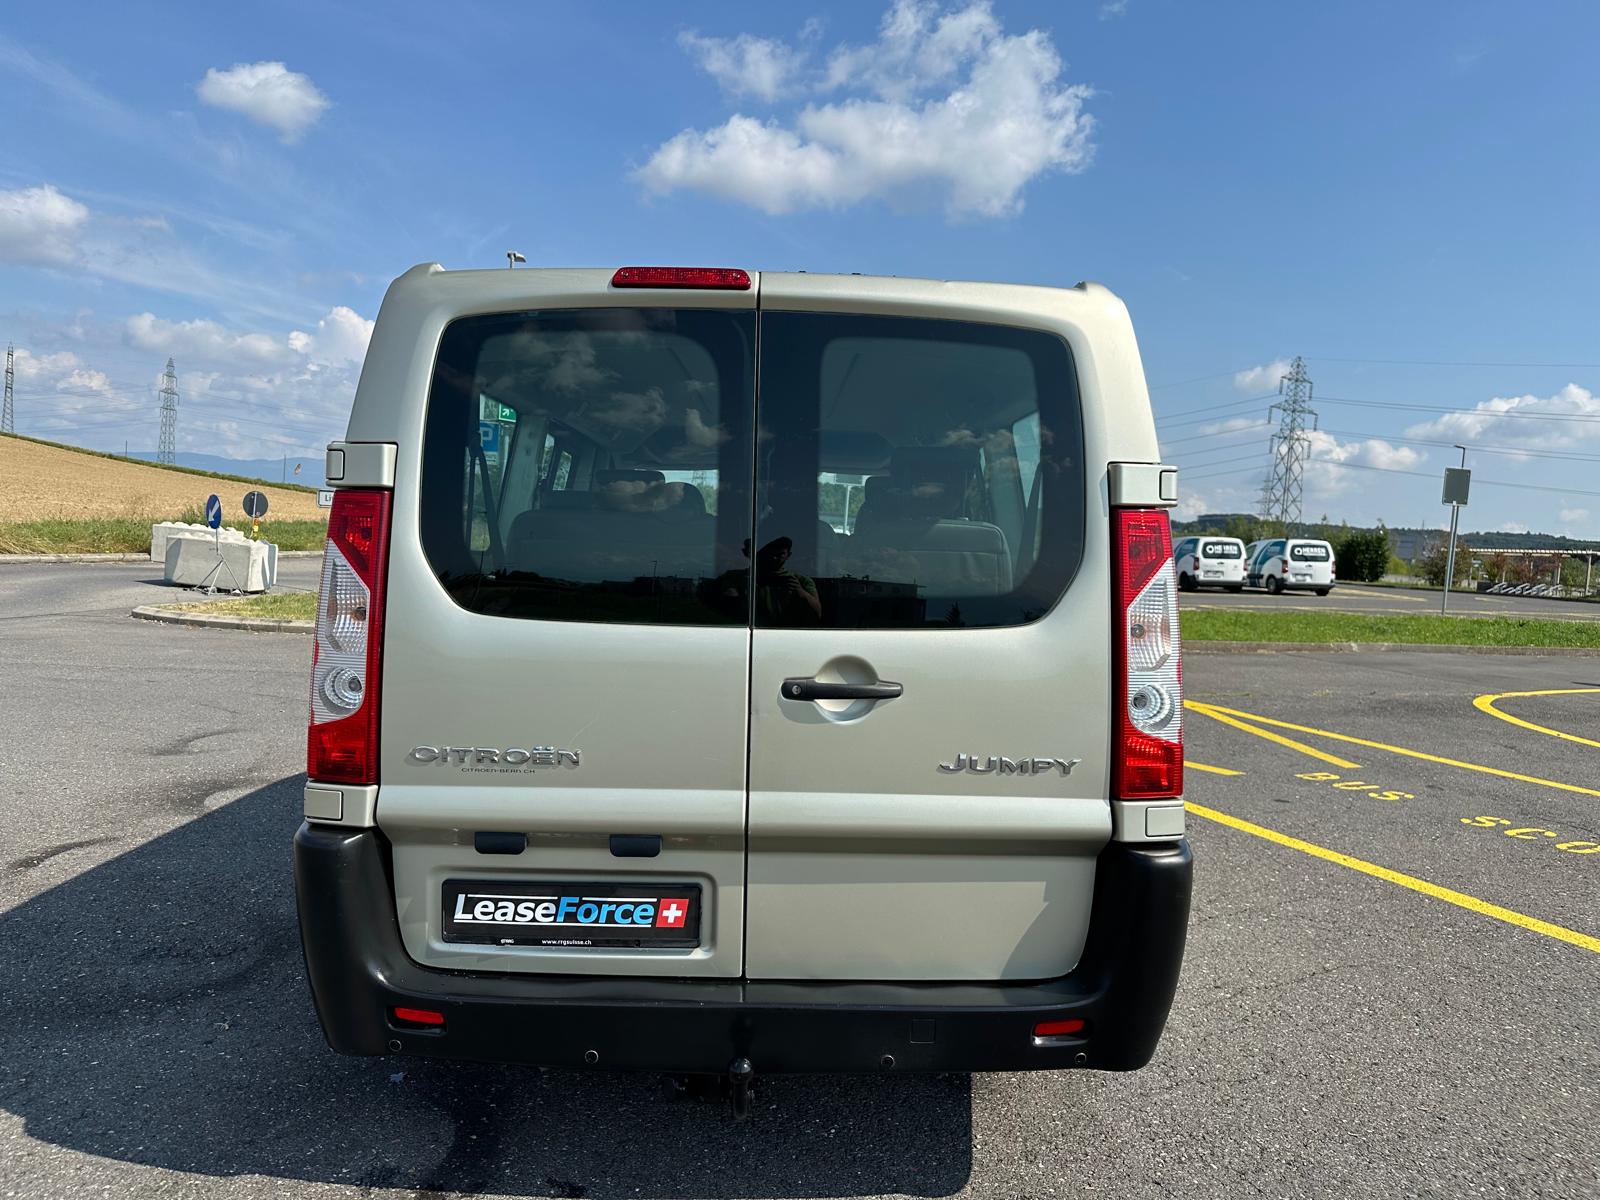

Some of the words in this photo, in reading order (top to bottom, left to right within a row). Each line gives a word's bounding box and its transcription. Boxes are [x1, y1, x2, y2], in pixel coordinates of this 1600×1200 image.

[409, 745, 581, 767] CITROËN
[939, 753, 1082, 775] JUMPY
[1294, 772, 1415, 801] BUS
[454, 893, 654, 925] LeaseForce
